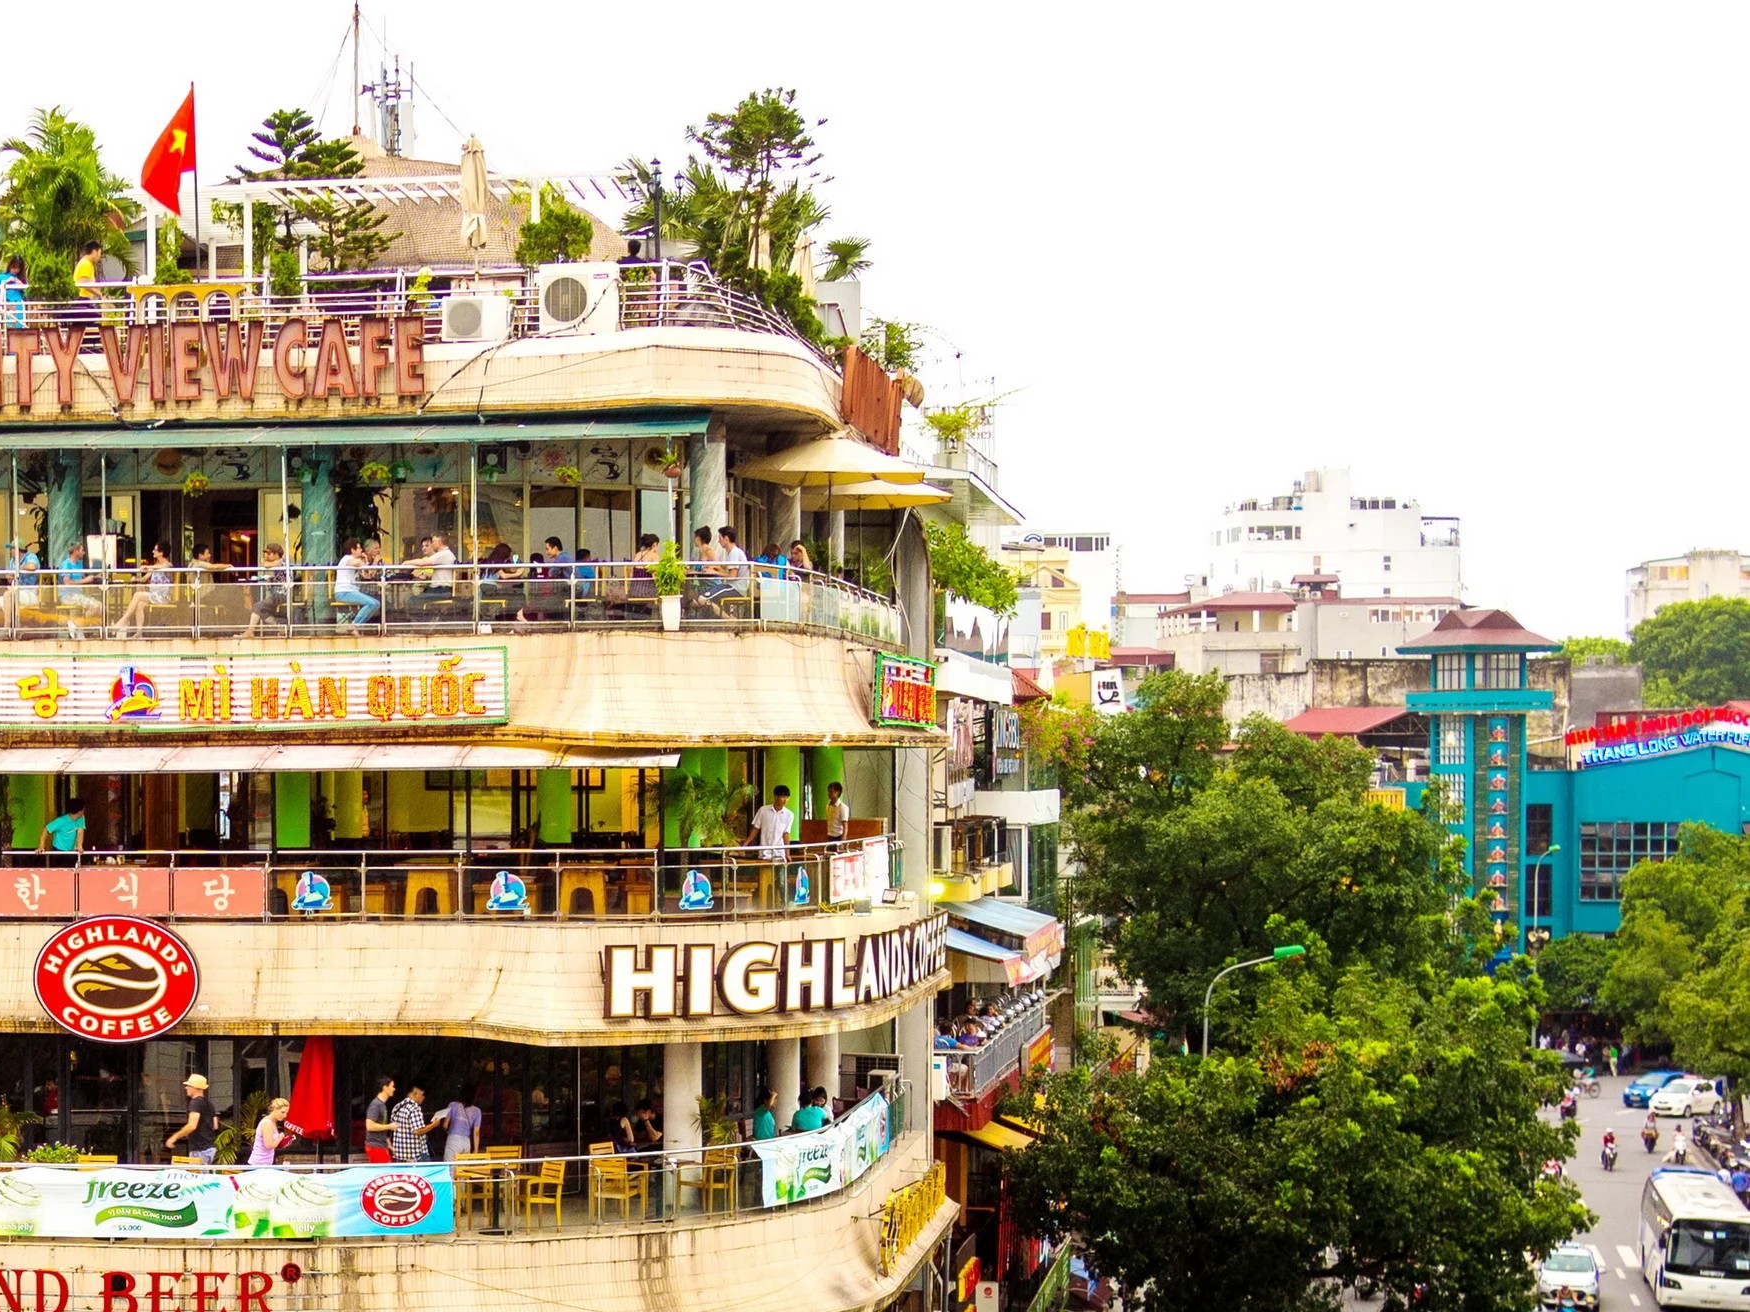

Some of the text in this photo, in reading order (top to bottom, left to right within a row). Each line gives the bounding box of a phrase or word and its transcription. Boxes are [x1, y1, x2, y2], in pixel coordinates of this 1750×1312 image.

[99, 320, 265, 404] VIEW
[273, 316, 425, 399] CAFE
[178, 656, 487, 721] MÌ HÀN QUỐC
[1639, 736, 1679, 756] LONG
[43, 924, 188, 977] HIGHLANDS
[603, 928, 911, 1020] HIGHLANDS
[61, 1004, 173, 1036] COFFEE
[82, 1176, 182, 1204] freeze
[365, 1173, 432, 1198] HIGHLANDS
[295, 1223, 316, 1234] jelly
[372, 1208, 424, 1225] COFFEE
